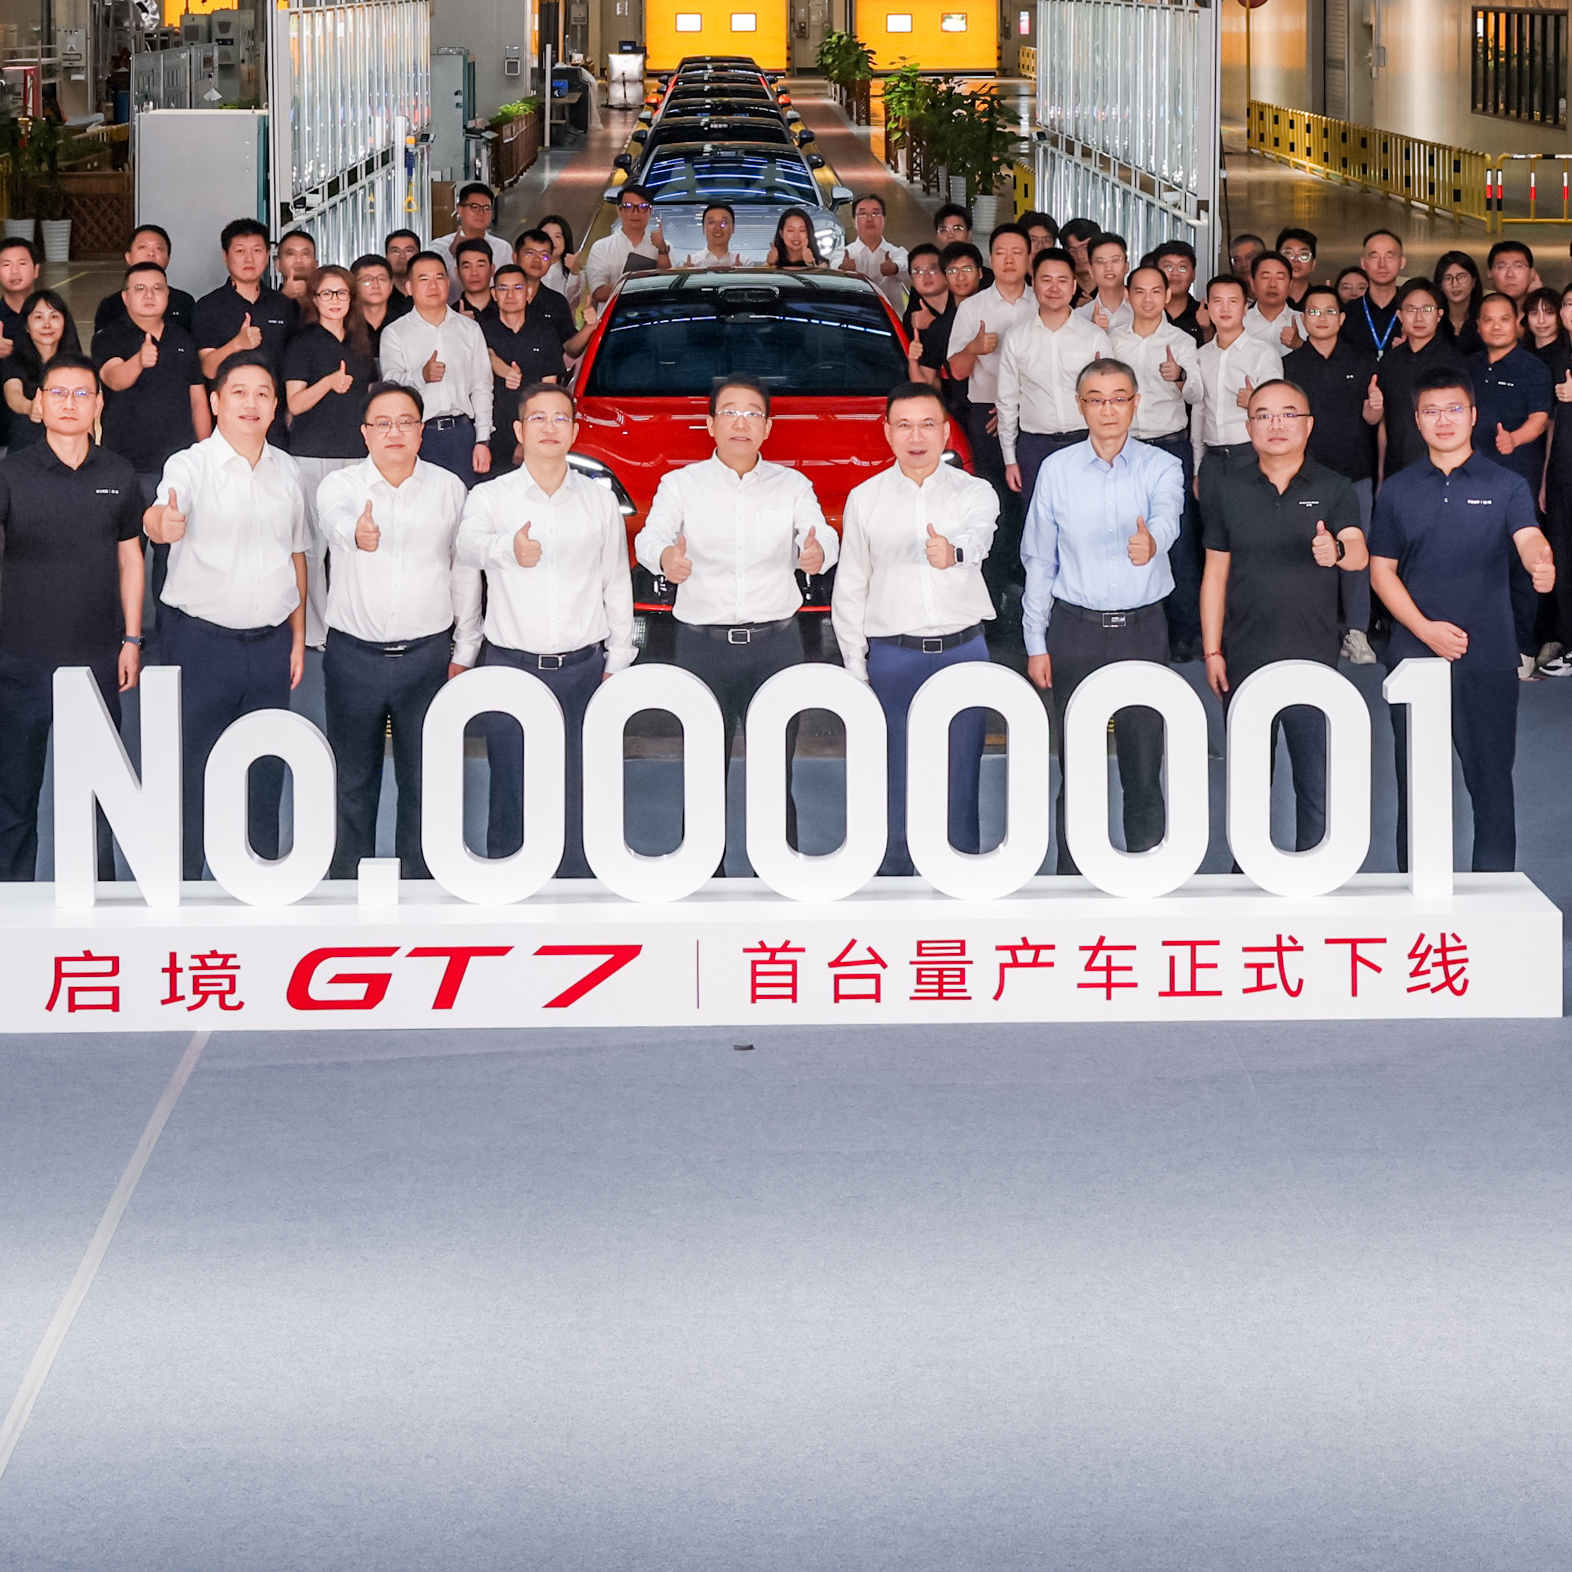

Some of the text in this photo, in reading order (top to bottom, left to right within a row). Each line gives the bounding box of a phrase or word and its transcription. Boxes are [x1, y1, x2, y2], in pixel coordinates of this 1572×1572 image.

[53, 657, 1454, 908] No.0000001
[44, 932, 1470, 1014] 启境 GT7 首台量产车正式下线
